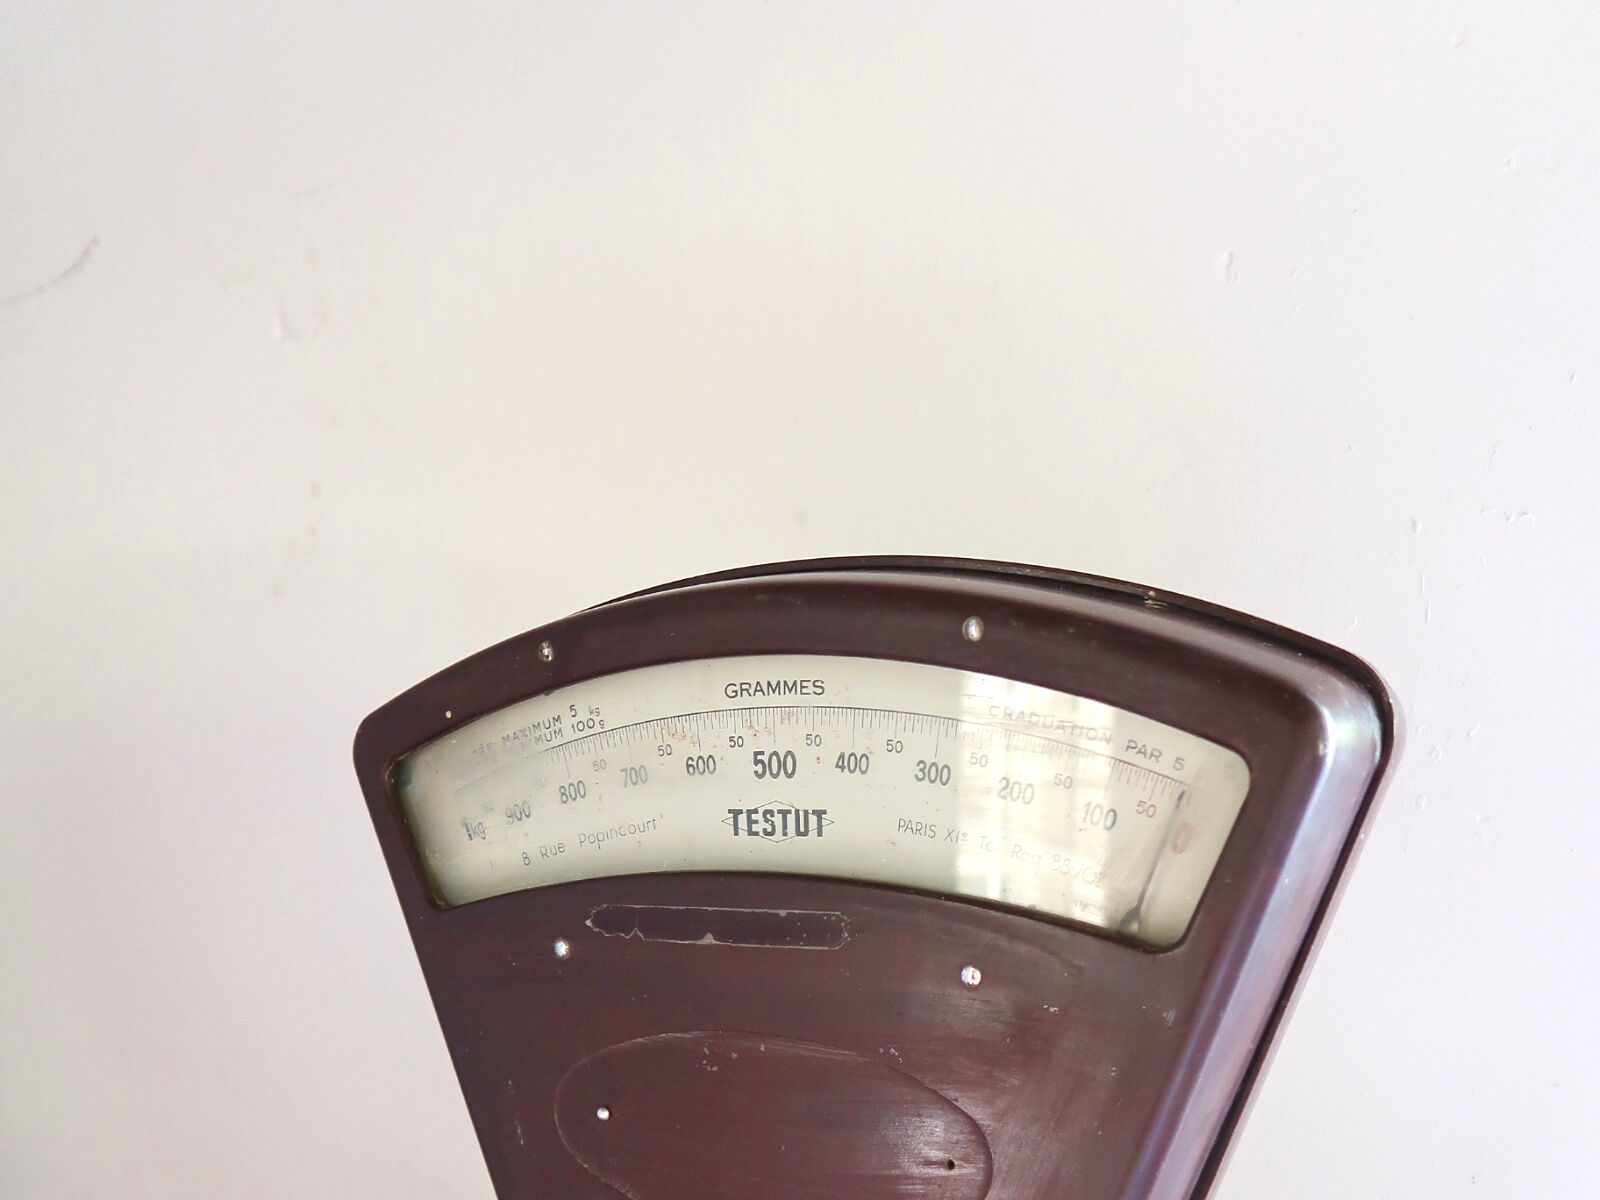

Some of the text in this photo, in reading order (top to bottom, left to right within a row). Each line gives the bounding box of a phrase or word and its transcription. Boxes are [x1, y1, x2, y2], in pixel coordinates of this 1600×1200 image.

[724, 680, 826, 699] GRAMMES
[502, 704, 601, 745] MAXIMUM 5 kg
[571, 718, 596, 734] 100
[1125, 738, 1162, 764] PAR
[1171, 756, 1185, 771] 5
[505, 801, 532, 825] 900
[558, 779, 587, 804] 800
[620, 765, 648, 788] 700
[686, 754, 716, 777] 600
[753, 750, 797, 779] 500
[835, 751, 869, 775] 400
[914, 760, 951, 786] 300
[996, 776, 1035, 805] 200
[1082, 801, 1117, 831] 100
[593, 733, 1157, 818] 50 50 50 50 50 50 50 50
[727, 808, 828, 838] TESTUT
[897, 818, 937, 839] PARIS
[521, 818, 657, 866] 8 Rue Popincourt
